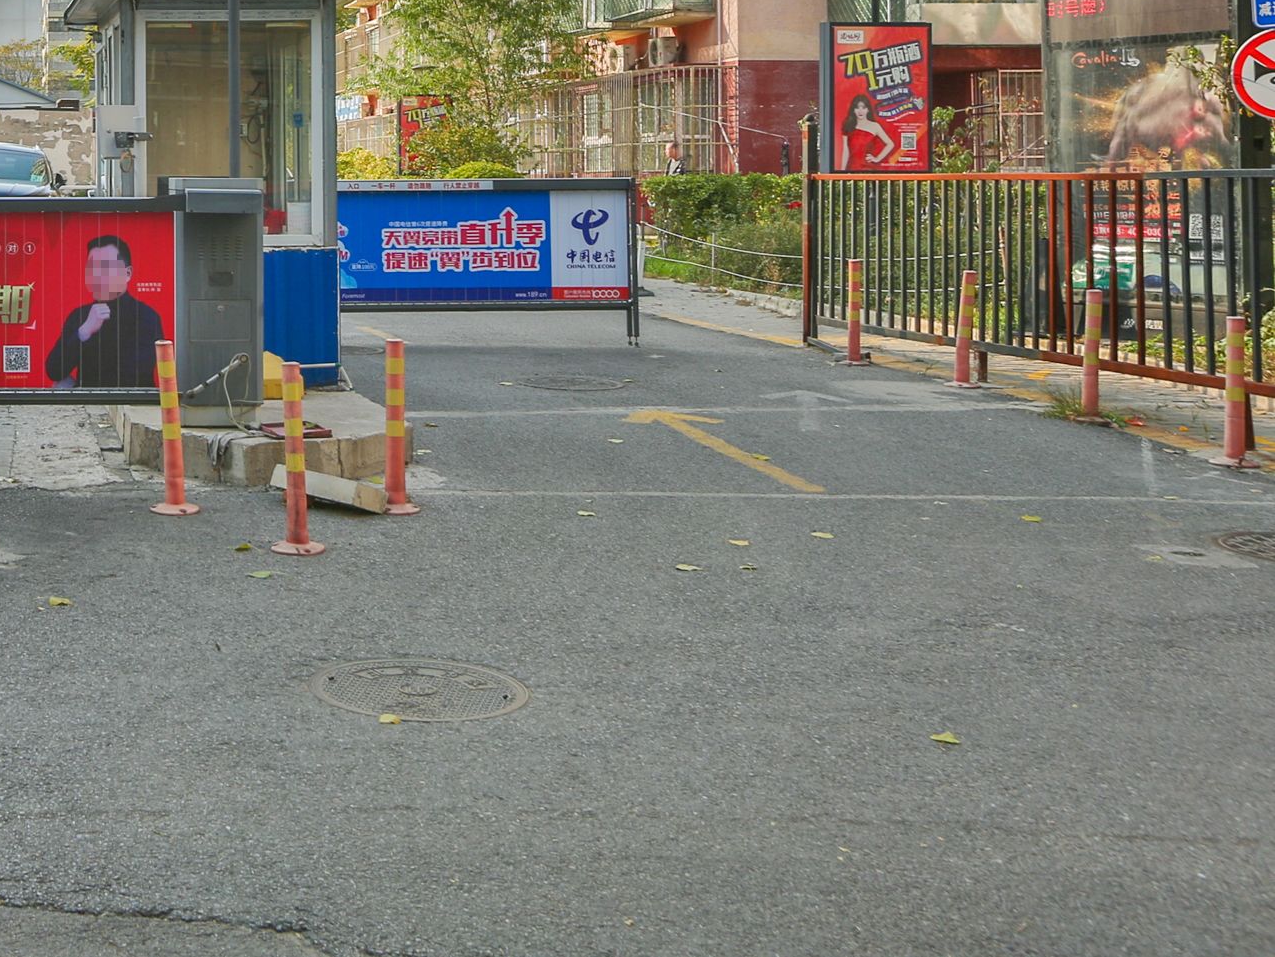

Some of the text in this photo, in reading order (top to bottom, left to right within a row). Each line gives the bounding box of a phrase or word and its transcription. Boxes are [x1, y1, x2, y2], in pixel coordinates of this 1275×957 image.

[1258, 1, 1275, 17] 减
[566, 249, 616, 263] 中国电信
